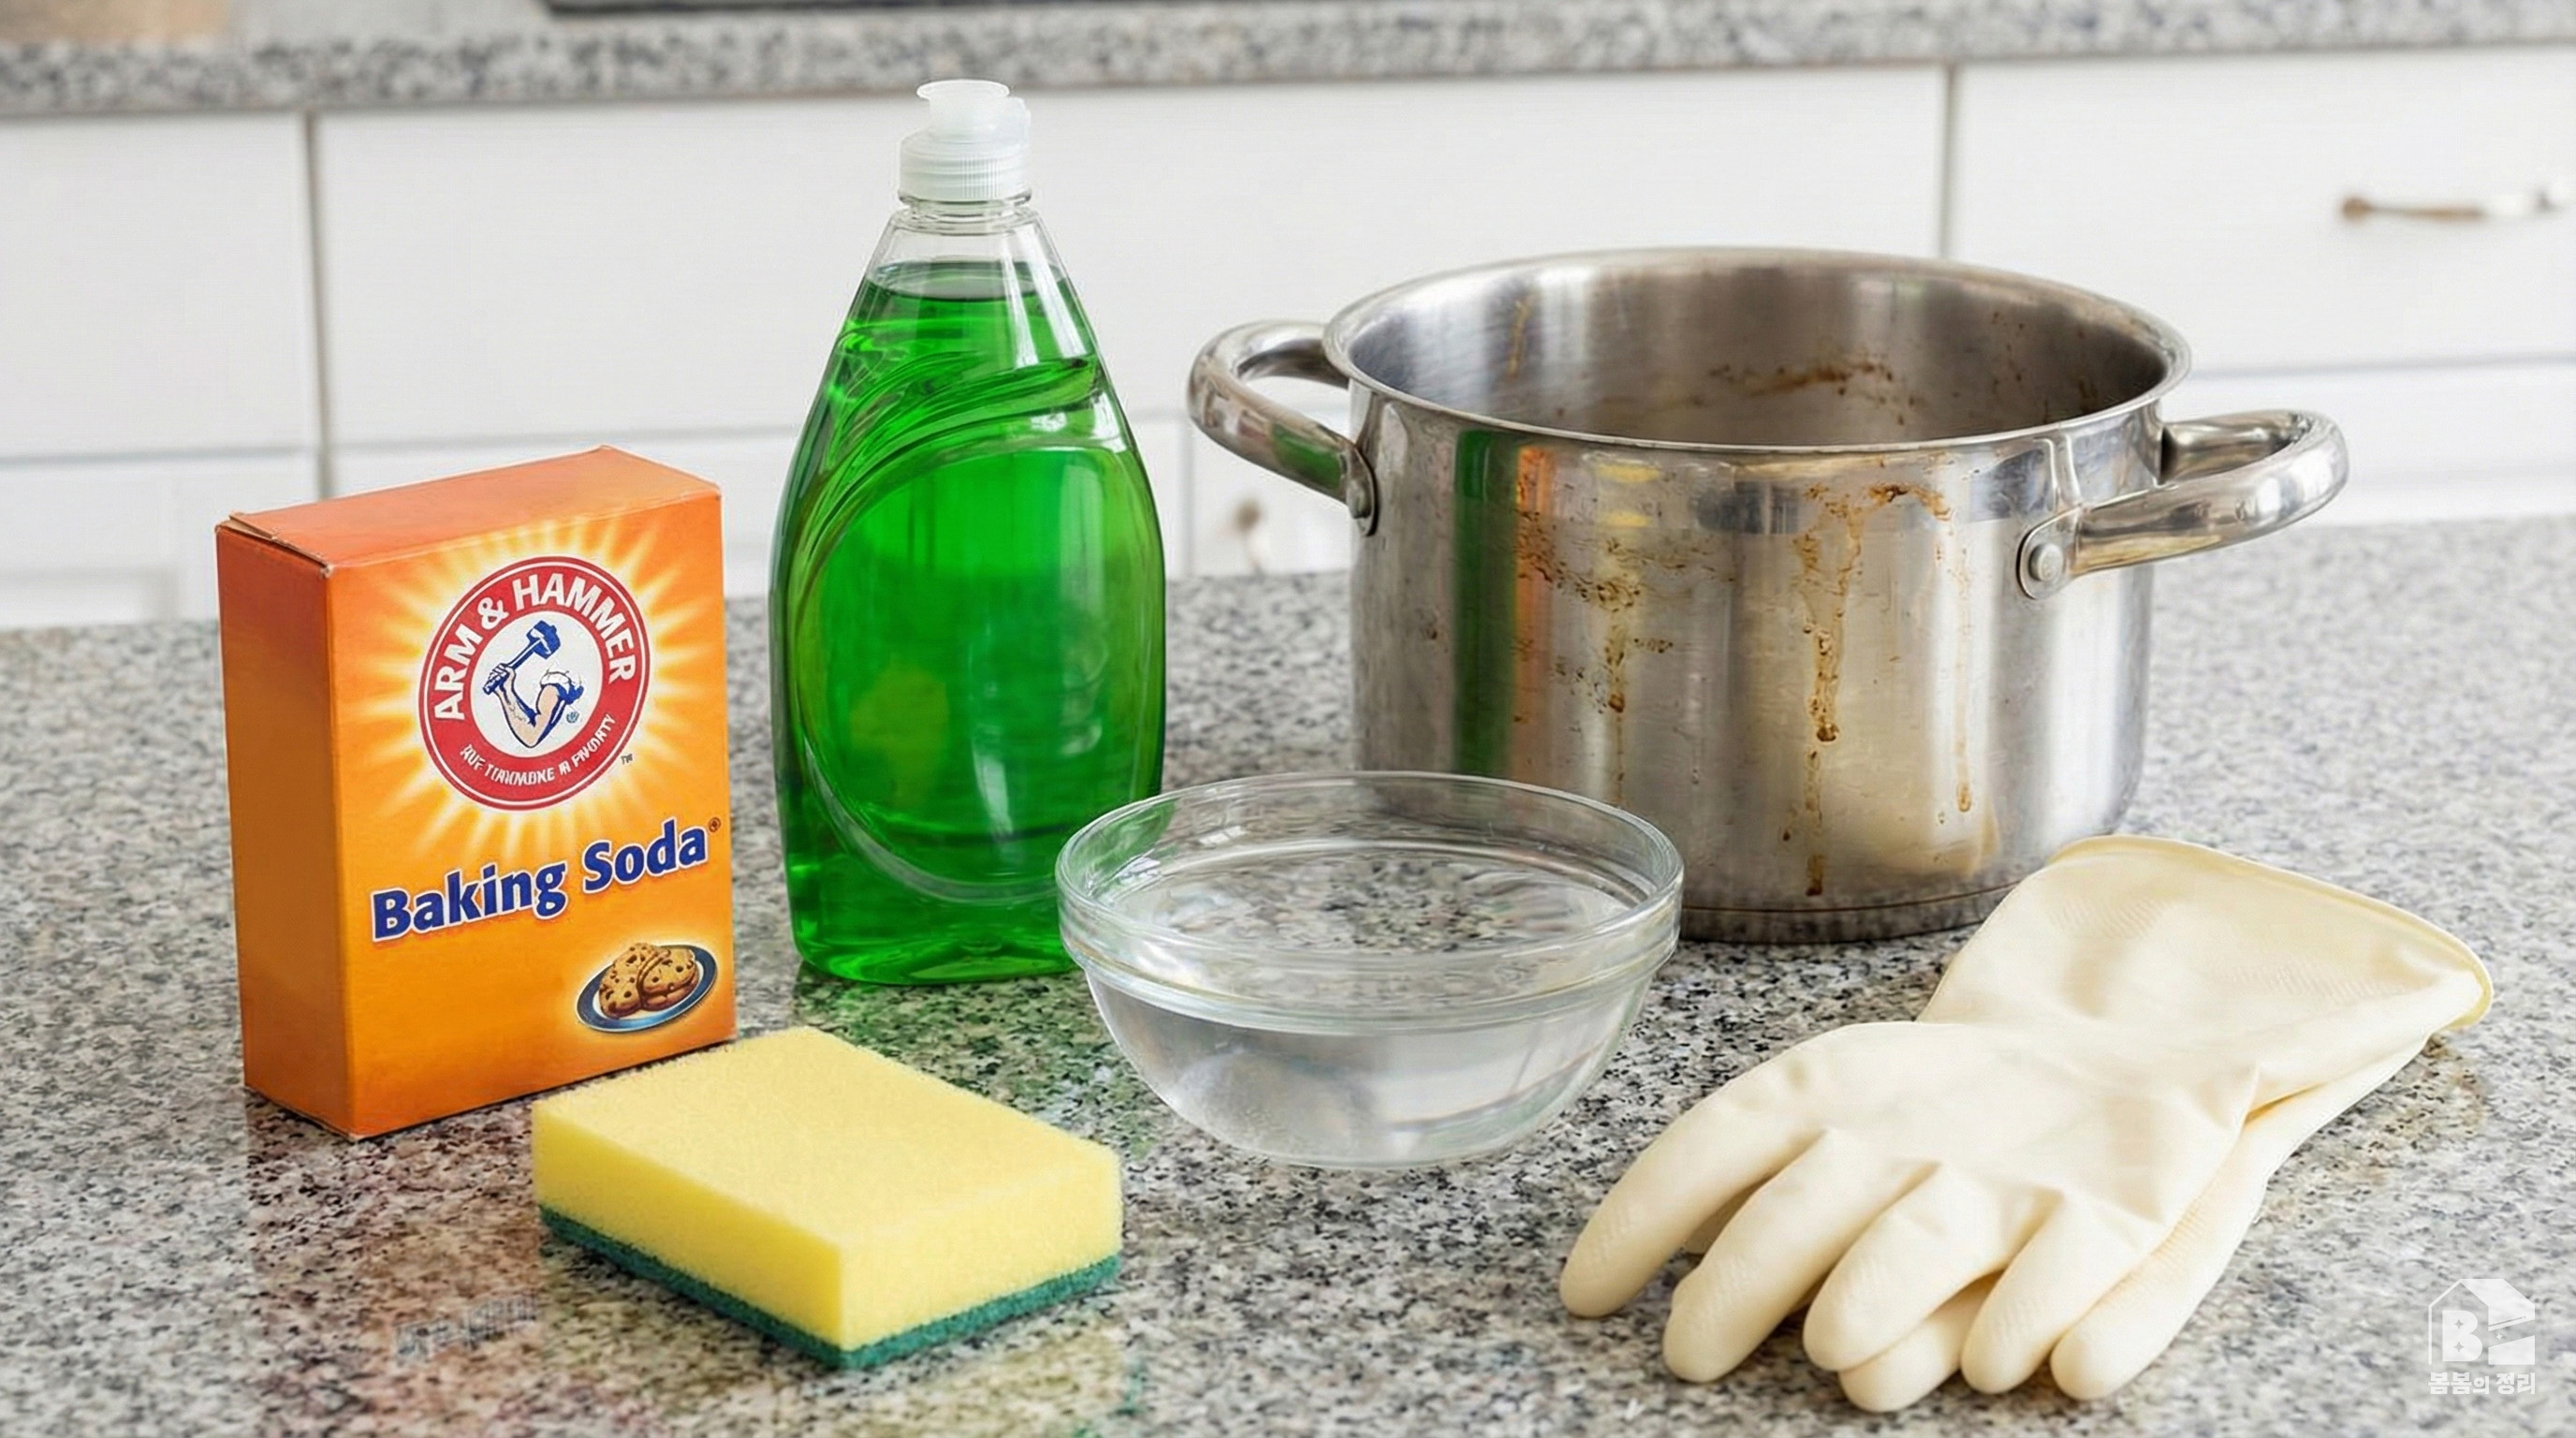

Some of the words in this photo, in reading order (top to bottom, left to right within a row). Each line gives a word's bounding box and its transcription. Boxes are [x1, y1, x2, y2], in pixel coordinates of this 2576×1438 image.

[434, 624, 483, 721] ARM
[476, 596, 509, 630] &
[512, 573, 637, 684] HAMMER
[372, 863, 567, 941] Baking
[582, 818, 707, 891] Soda
